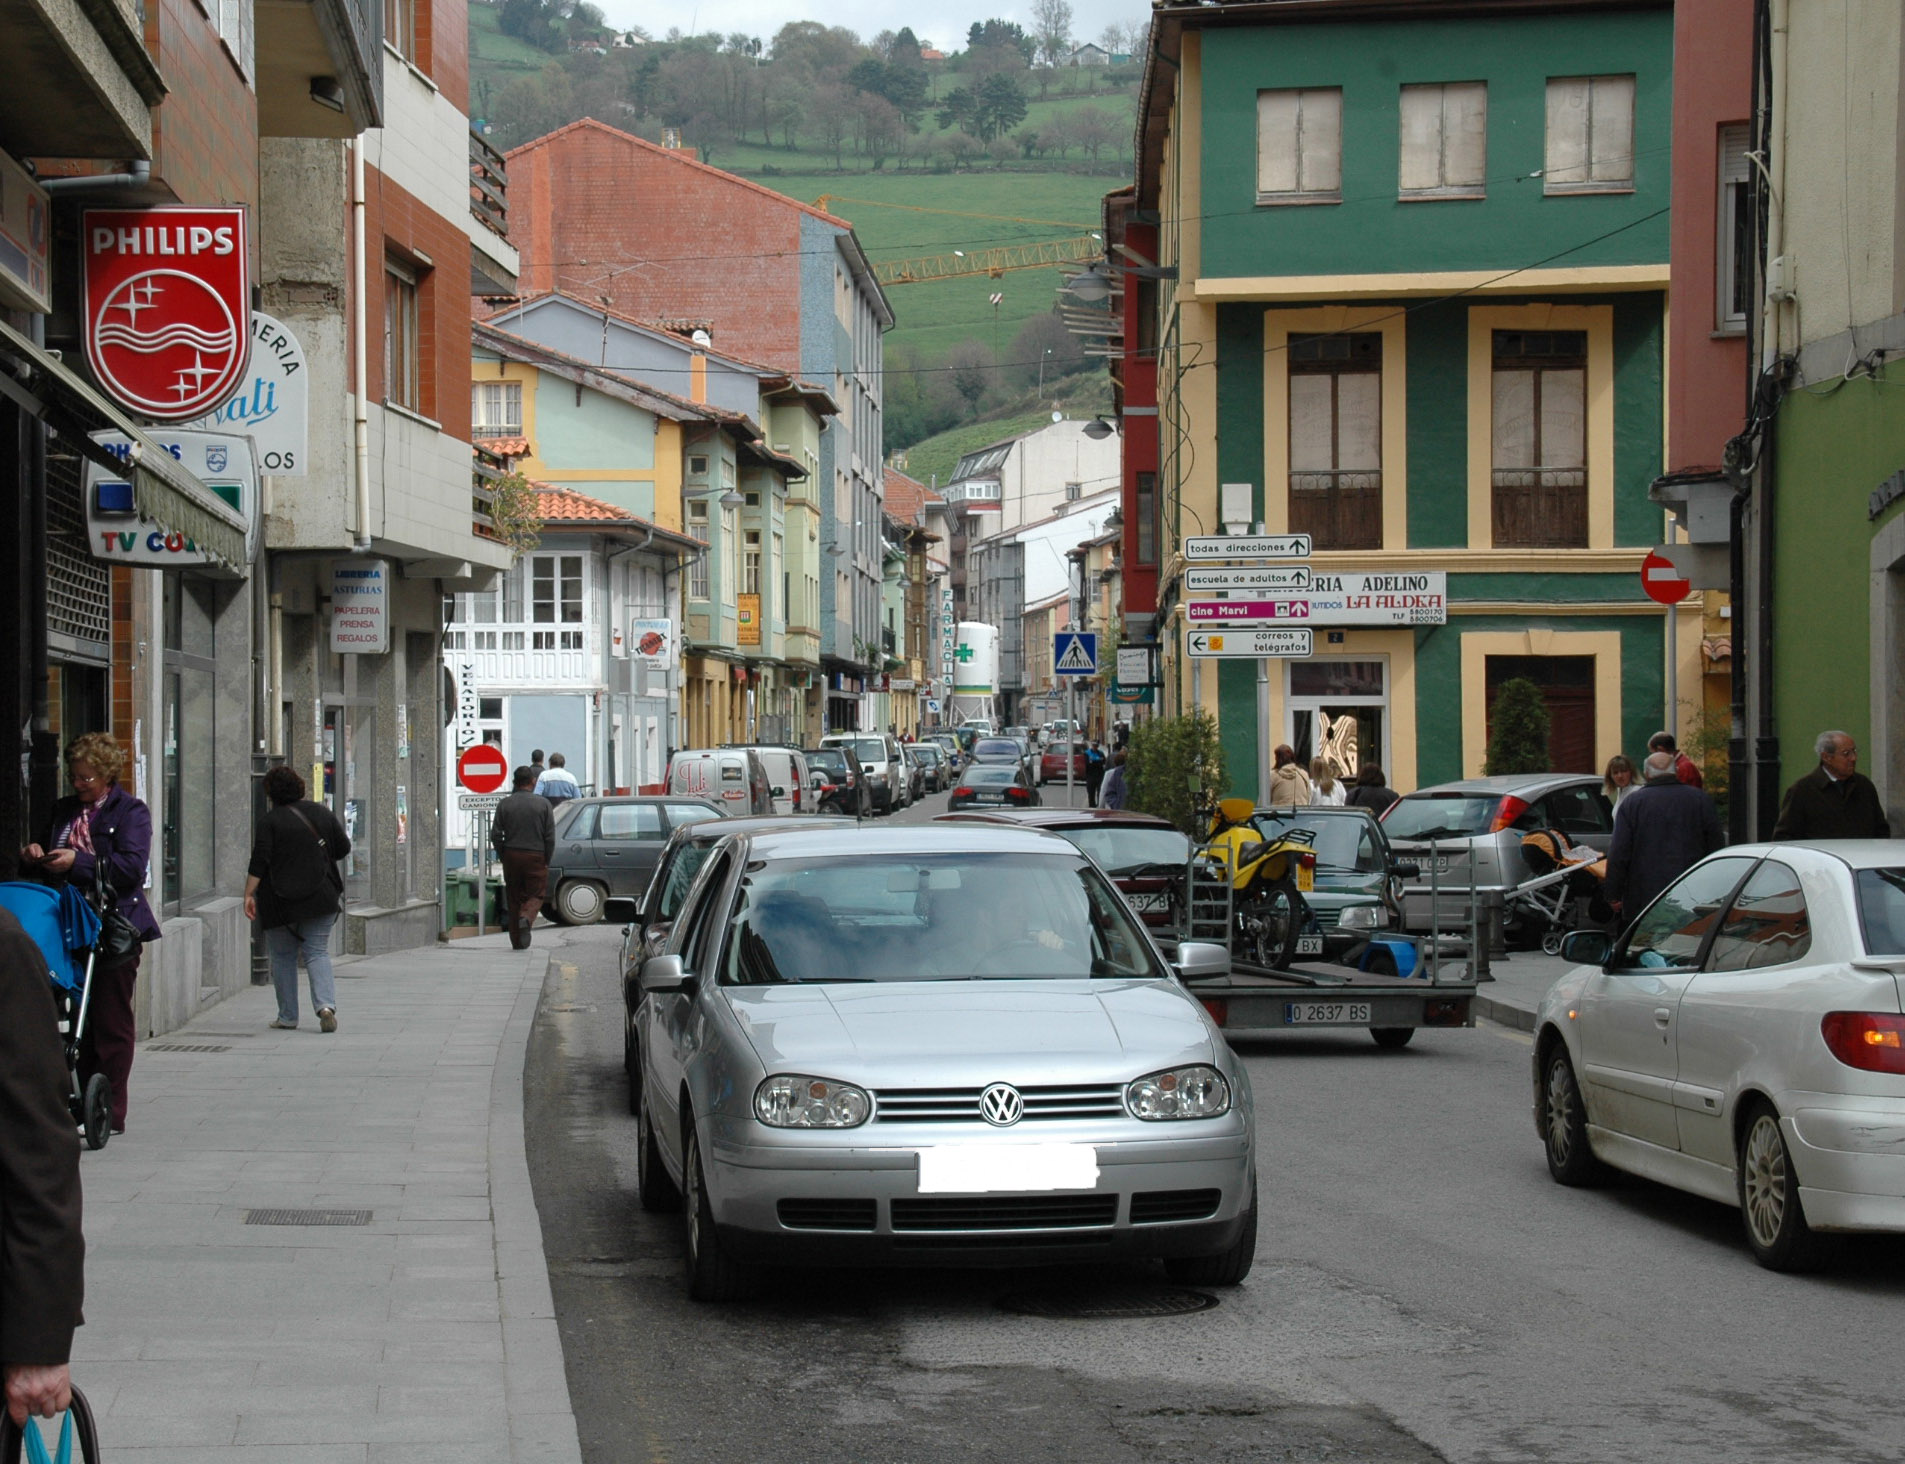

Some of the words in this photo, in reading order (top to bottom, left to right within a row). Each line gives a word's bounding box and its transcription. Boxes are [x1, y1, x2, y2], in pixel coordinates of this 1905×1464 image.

[93, 226, 234, 256] PHILIPS
[101, 532, 137, 552] TV
[1190, 545, 1219, 553] todas
[1226, 543, 1285, 552] direcciones
[336, 571, 381, 579] LIBRERIA
[1191, 575, 1228, 584] escuela
[1233, 575, 1245, 583] de
[1249, 574, 1287, 583] adultos
[1362, 576, 1428, 592] ADELINO
[334, 586, 382, 594] ASTURIAS
[1346, 595, 1370, 608] LA
[334, 606, 380, 614] PAPELERIA
[1191, 607, 1213, 616] cine
[1218, 606, 1248, 615] Marvi
[1392, 612, 1405, 620] TLF
[340, 620, 374, 628] PRENSA
[337, 634, 378, 642] REGALOS
[943, 591, 952, 684] FARMACIA
[1256, 632, 1294, 640] correos
[1300, 633, 1307, 641] y
[1254, 642, 1307, 653] telégrafos
[1307, 1005, 1344, 1020] 2637
[1350, 1005, 1368, 1020] BS
